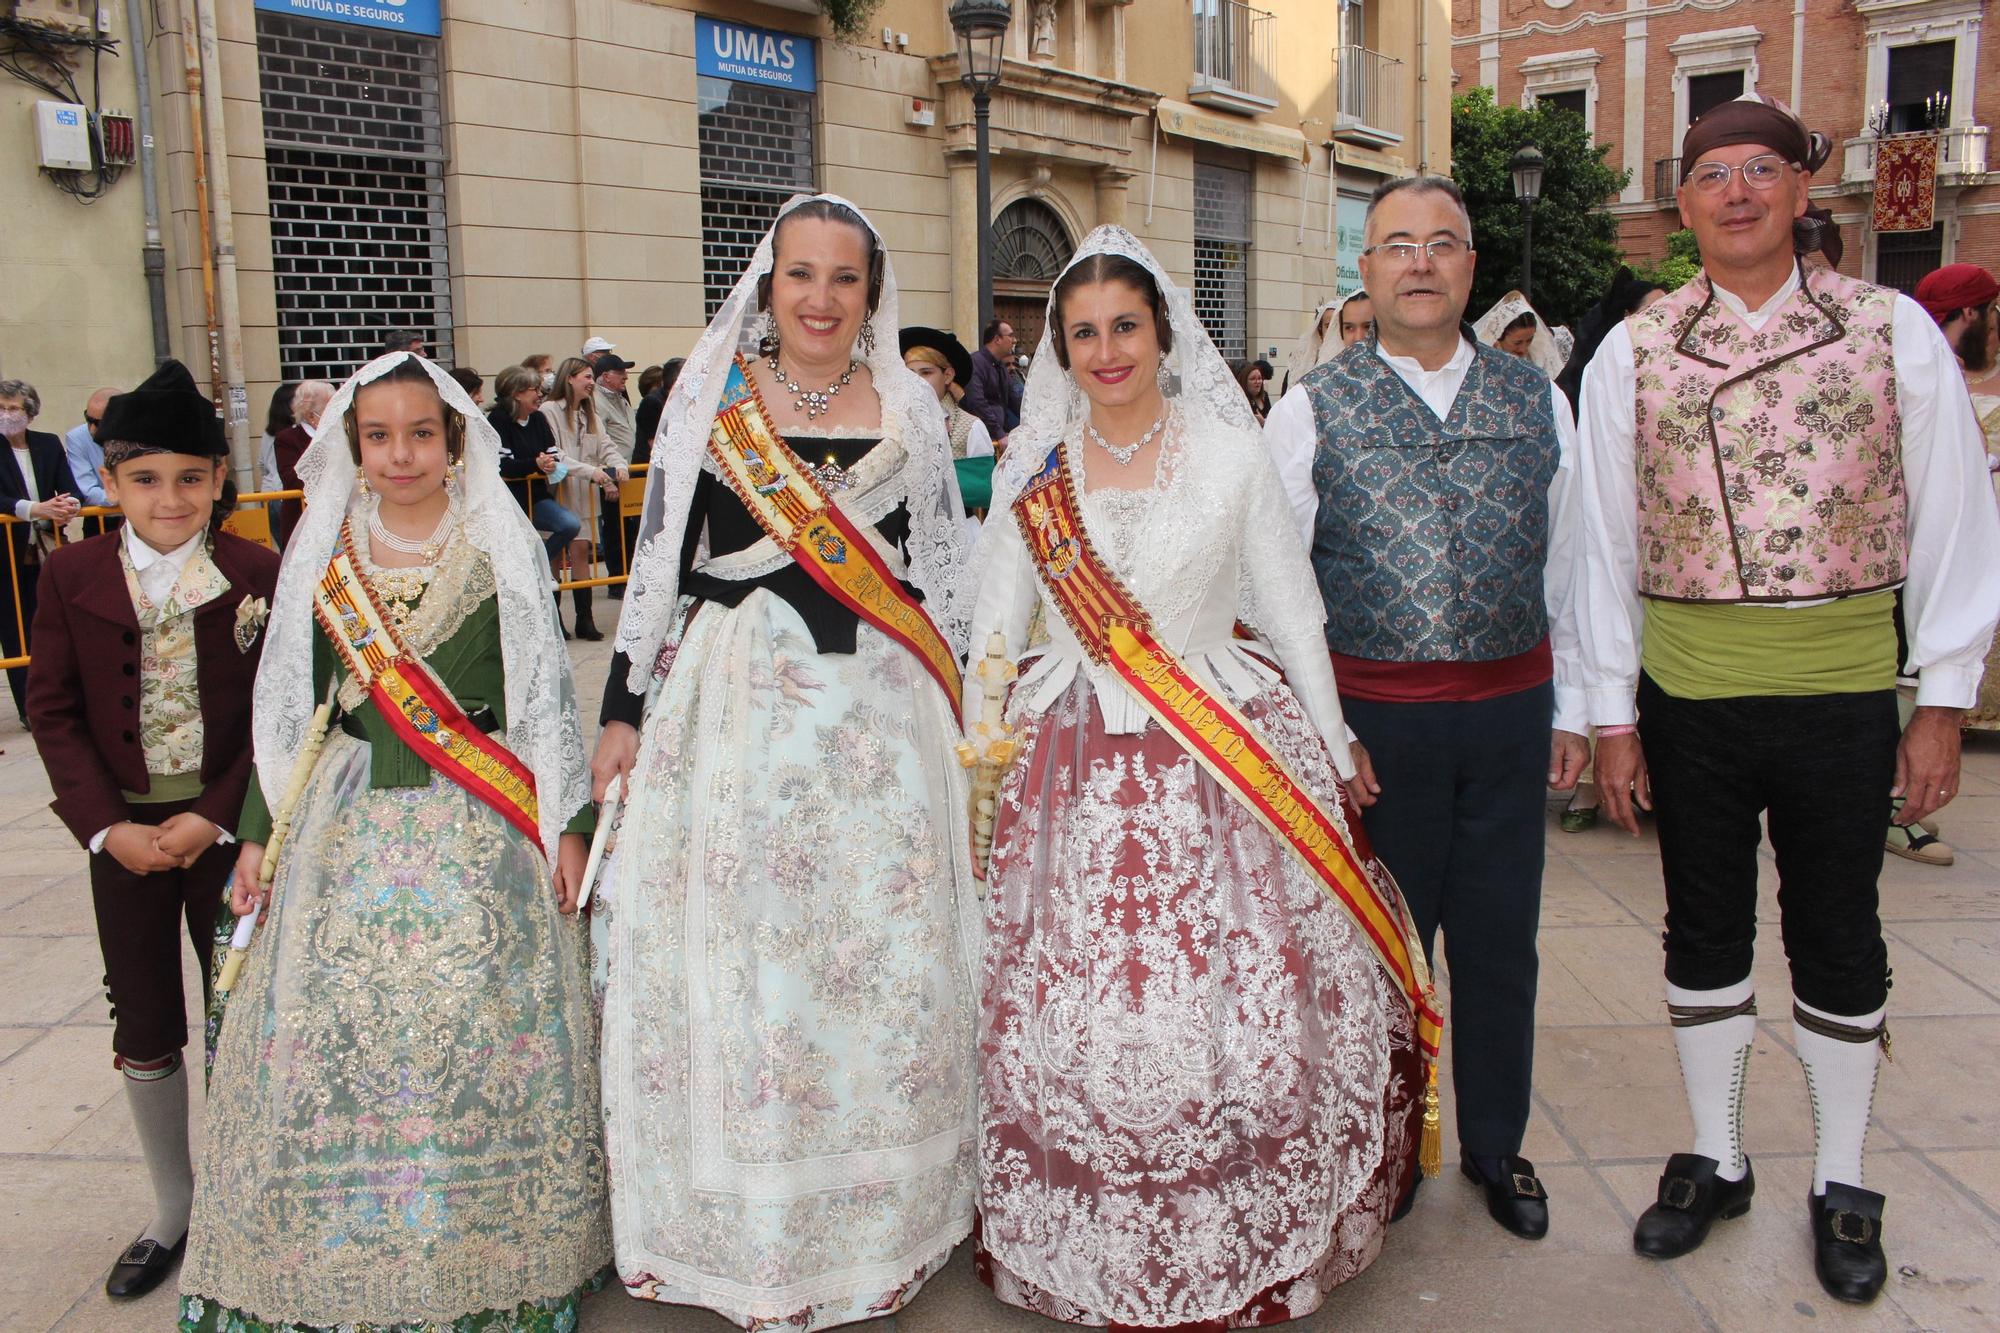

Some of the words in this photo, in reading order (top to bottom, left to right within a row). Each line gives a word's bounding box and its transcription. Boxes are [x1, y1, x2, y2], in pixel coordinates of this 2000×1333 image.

[291, 0, 333, 13] MUTUA
[336, 4, 351, 15] DE
[353, 6, 404, 23] SEGUROS
[713, 25, 795, 69] UMAS
[718, 61, 747, 75] MUTUA
[747, 67, 758, 77] DE
[758, 68, 793, 83] SEGUROS
[1336, 265, 1359, 279] Oficina
[1071, 579, 1104, 611] 2022
[1131, 649, 1245, 764] Fallera
